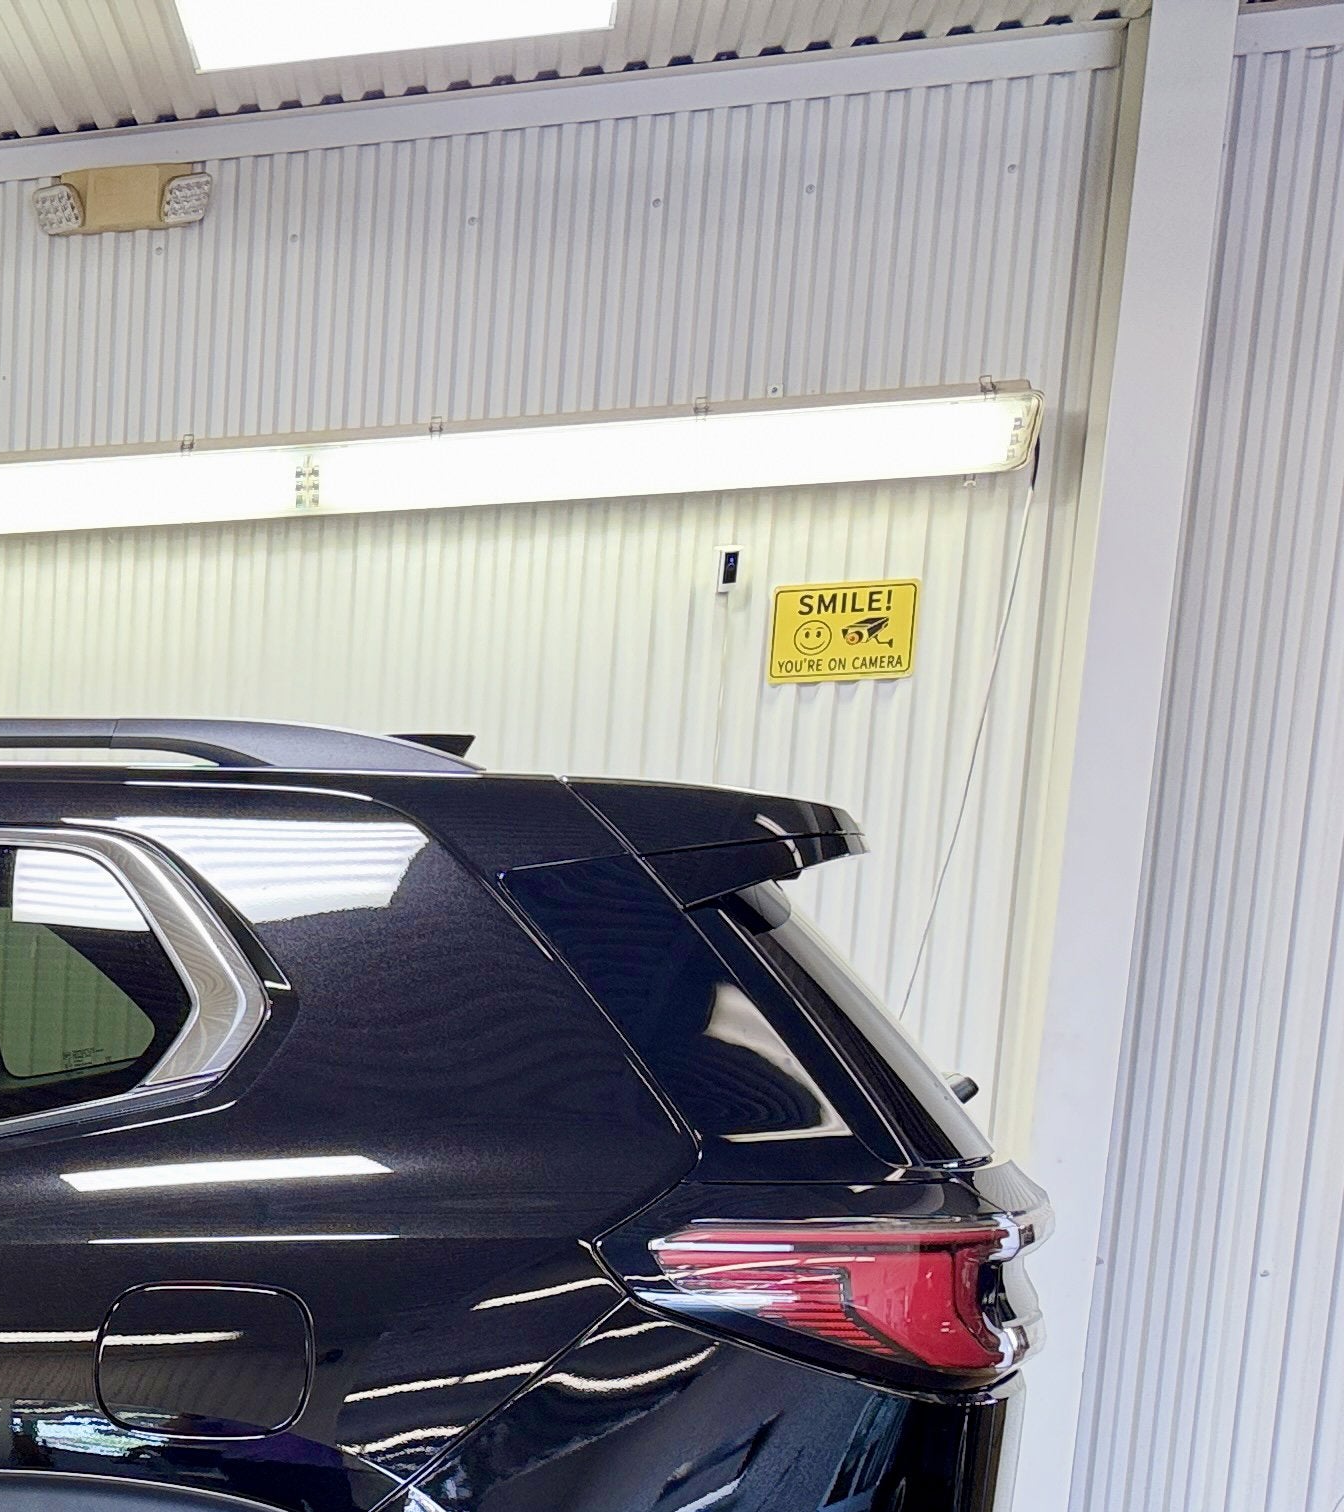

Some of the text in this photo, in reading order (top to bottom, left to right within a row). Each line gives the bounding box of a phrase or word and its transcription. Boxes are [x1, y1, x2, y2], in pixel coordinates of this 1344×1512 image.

[798, 589, 893, 615] SMILE!
[778, 655, 903, 673] YOU'RE ON CAMERA
